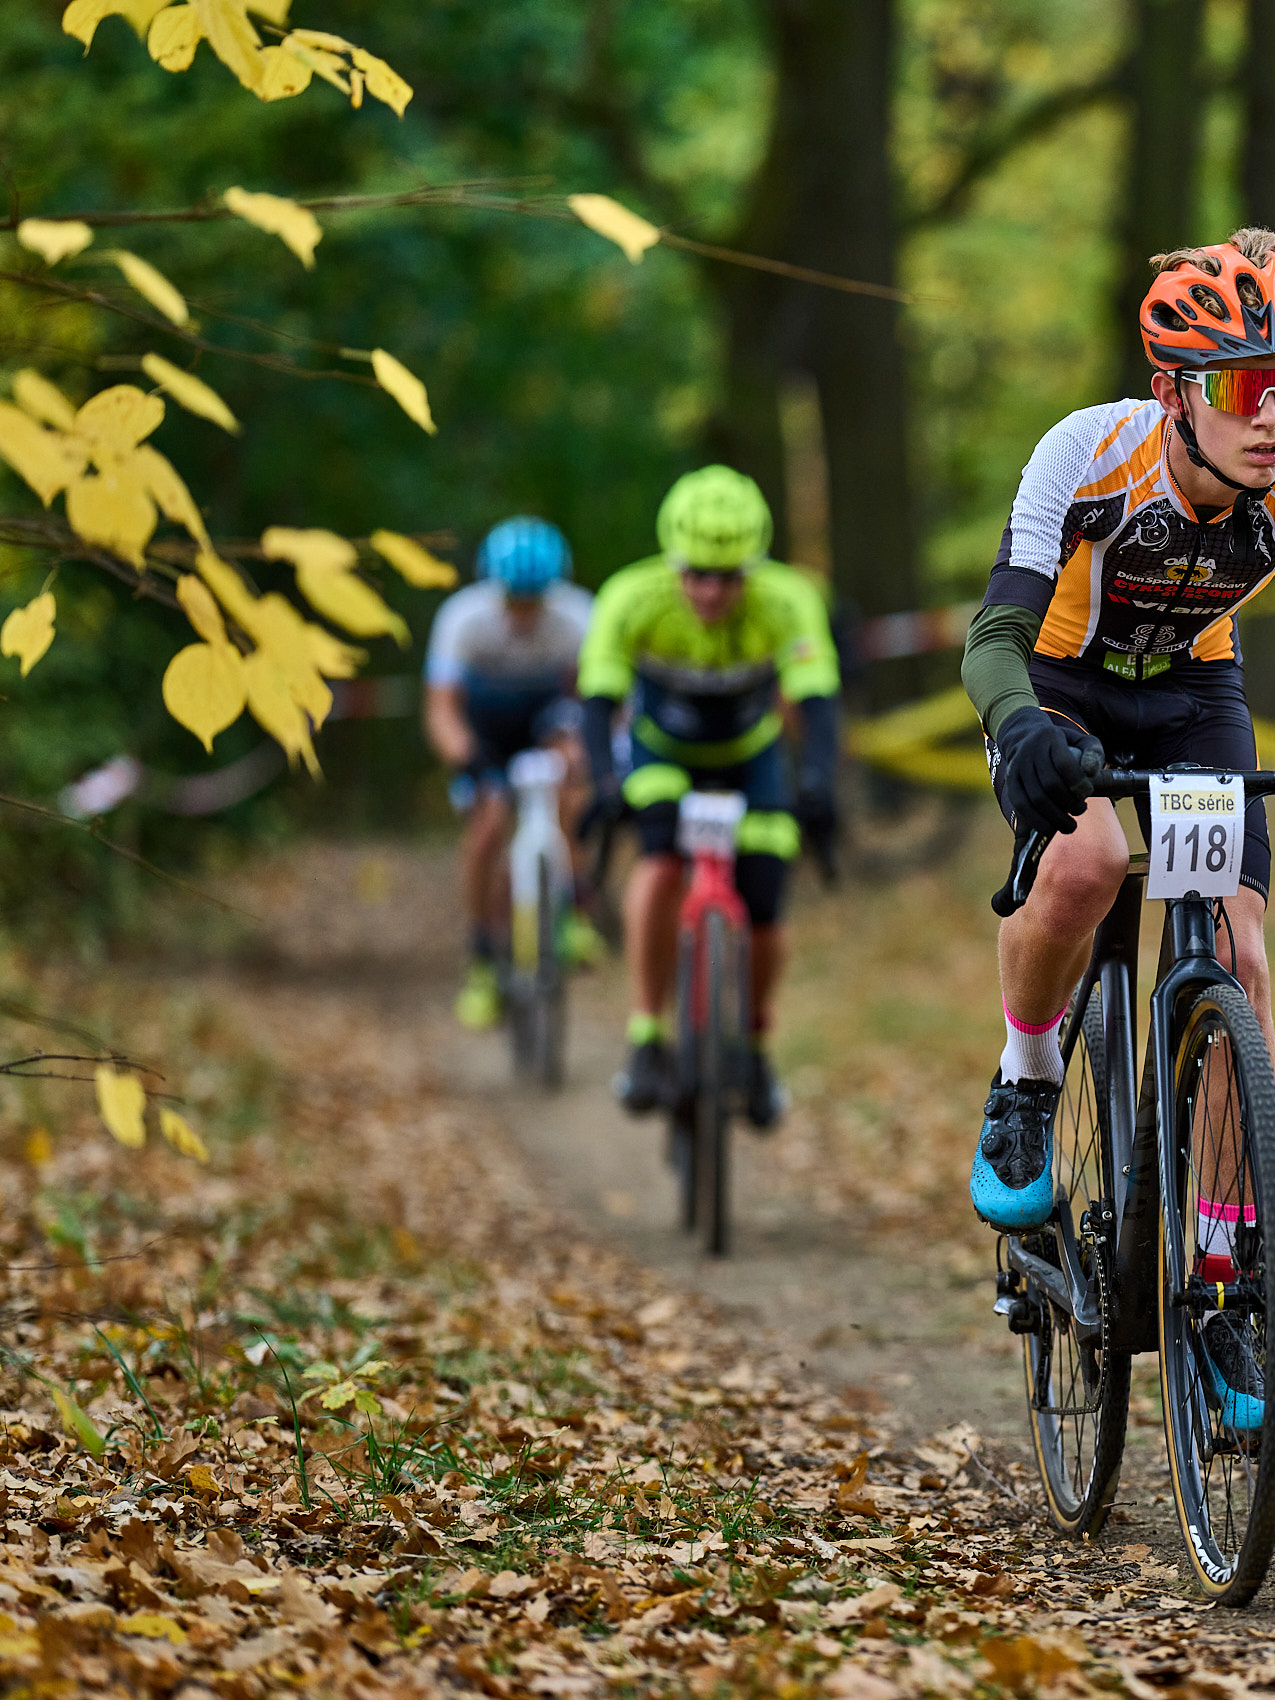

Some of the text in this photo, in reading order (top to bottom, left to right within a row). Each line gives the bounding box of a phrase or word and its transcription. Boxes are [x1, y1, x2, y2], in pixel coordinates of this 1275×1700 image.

[1160, 793, 1234, 811] TBC série
[1161, 823, 1227, 872] 118
